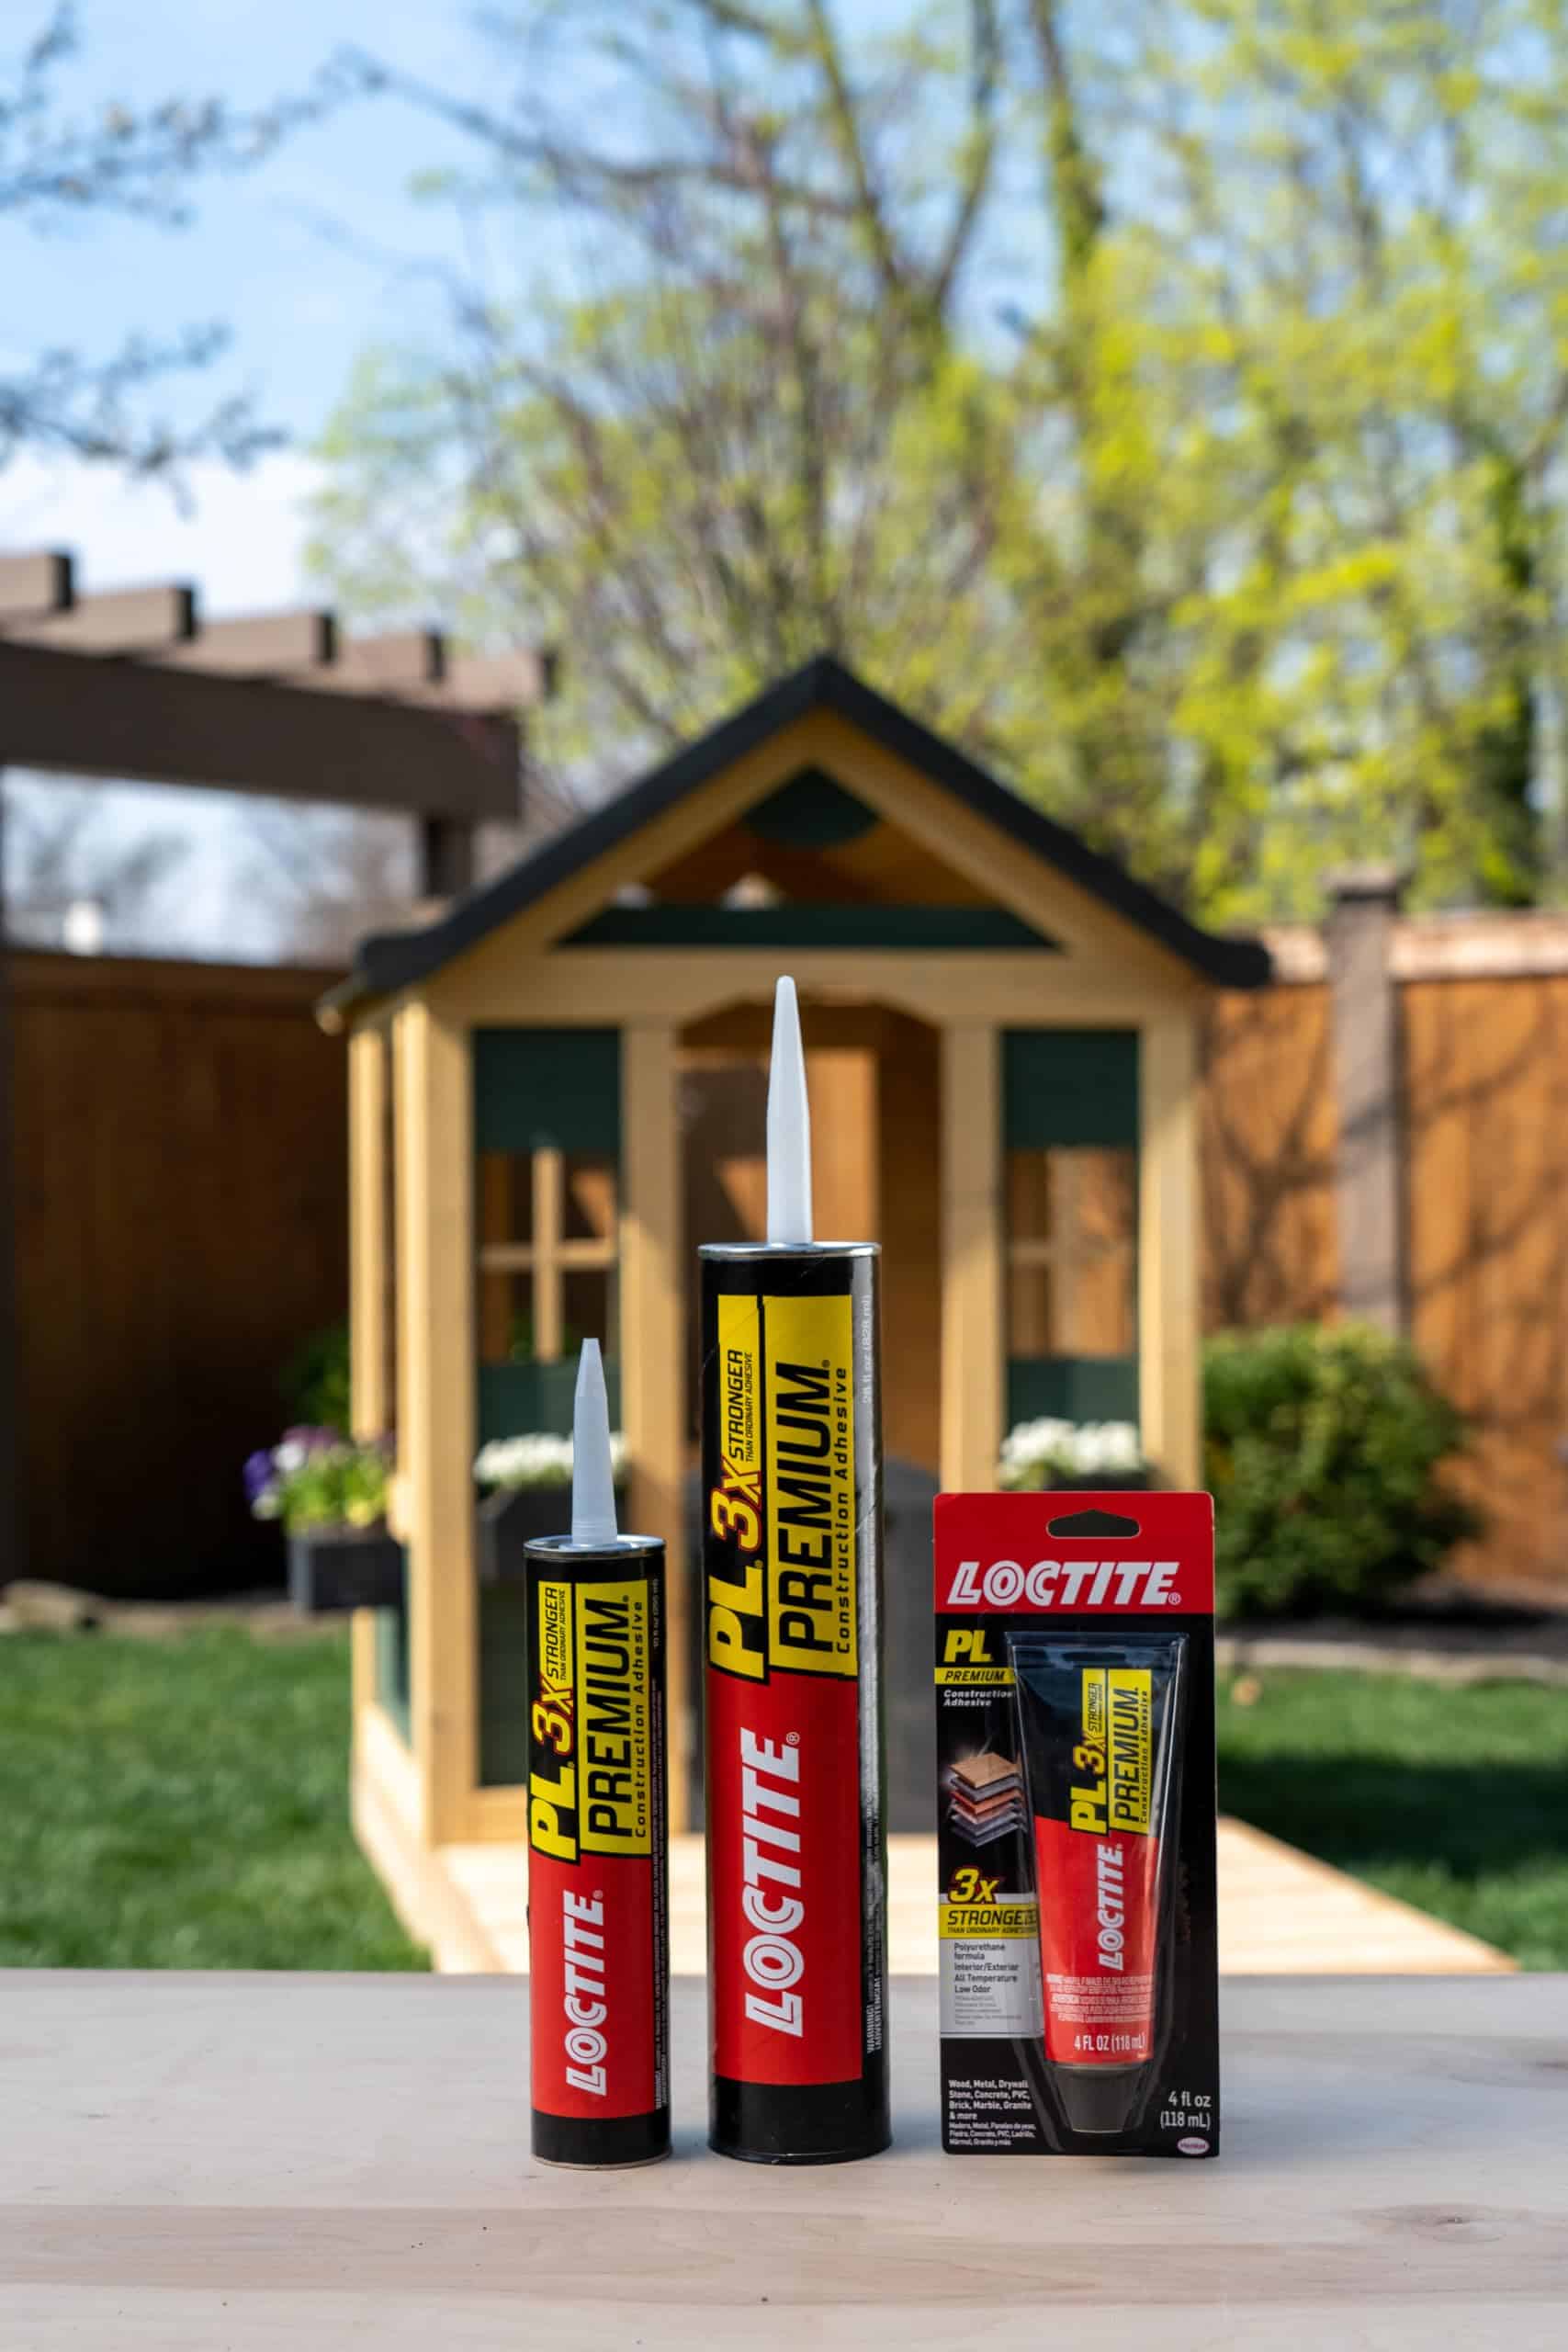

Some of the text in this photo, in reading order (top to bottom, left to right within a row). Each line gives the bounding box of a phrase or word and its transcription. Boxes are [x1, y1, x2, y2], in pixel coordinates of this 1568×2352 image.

[728, 1349, 745, 1462] STRONGER
[744, 1352, 753, 1462] THAN ORDINARY ADHESIVE
[833, 1367, 850, 1654] Construction Adhesive
[708, 1566, 764, 1679] PL
[545, 1587, 559, 1679] STRONGER
[942, 1629, 992, 1663] PL
[943, 1669, 1006, 1682] PREMIUM
[942, 1689, 1013, 1699] Construction
[942, 1698, 992, 1707] Adhesive
[631, 1601, 647, 1838] Construction Adhesive
[1138, 1690, 1148, 1824] Construction Adhesive
[529, 1766, 576, 1860] PL
[1070, 1778, 1107, 1834] PL
[954, 1942, 1006, 1951] Polyurethane
[954, 1951, 986, 1960] formula
[954, 1962, 1020, 1972] Interior/Exterior
[967, 1973, 1018, 1984] Temperature
[954, 1984, 992, 1993] Low Odor
[1074, 2034, 1081, 2051] 4
[1083, 2034, 1095, 2051] FL
[1096, 2034, 1110, 2052] OZ
[1003, 2100, 1032, 2110] Granite
[1168, 2090, 1213, 2108] 4 fl oz
[957, 2112, 978, 2120] more
[1160, 2110, 1211, 2132] (118 mL)
